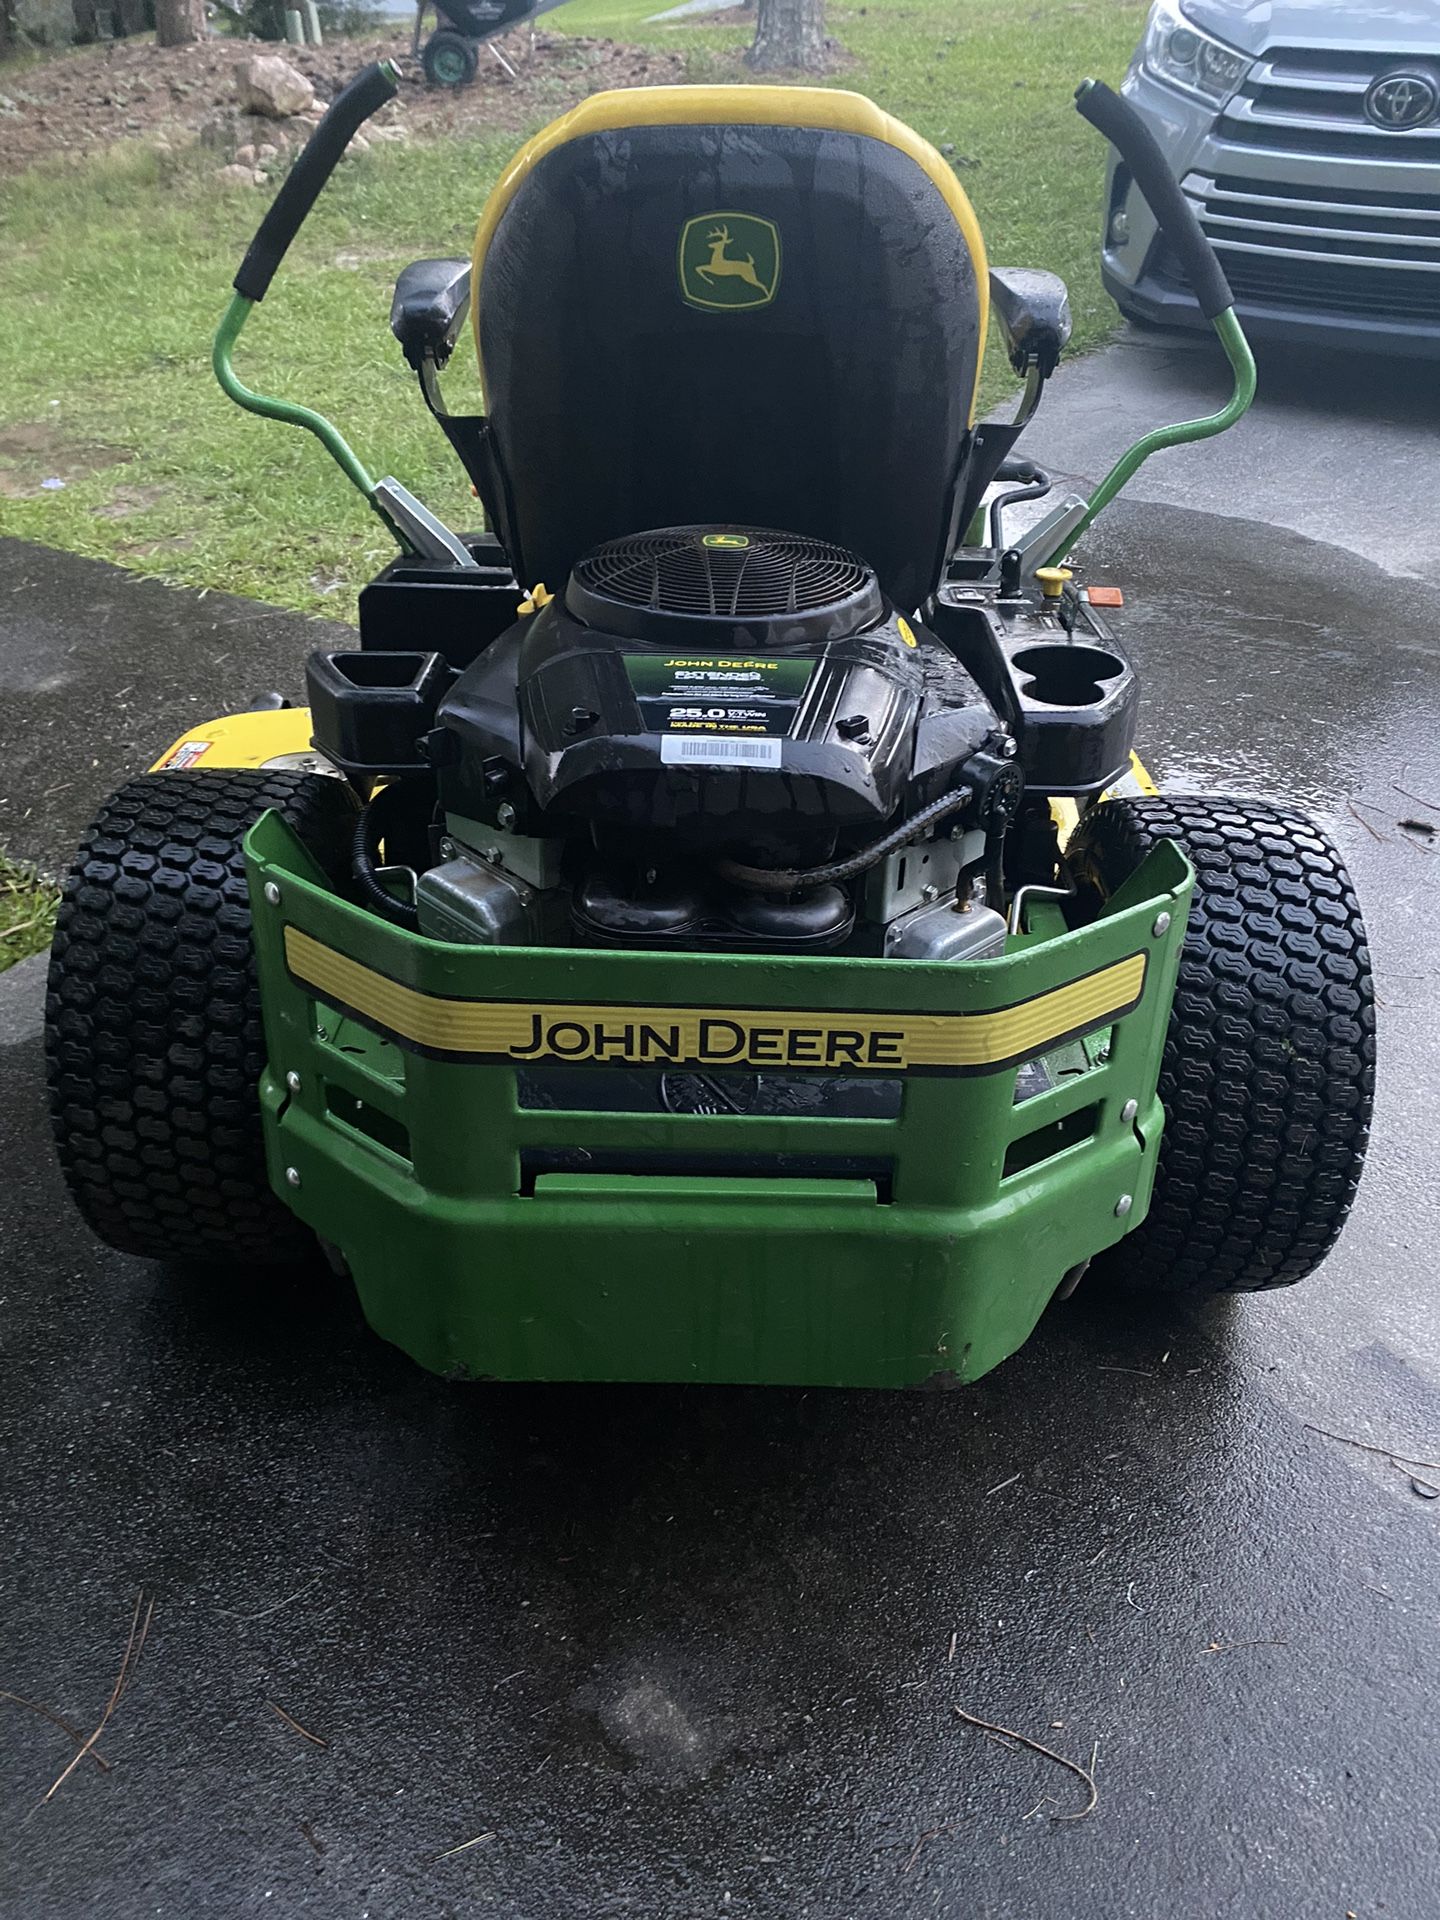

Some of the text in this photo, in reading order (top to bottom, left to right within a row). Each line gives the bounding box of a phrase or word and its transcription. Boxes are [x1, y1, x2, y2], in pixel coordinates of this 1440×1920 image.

[718, 660, 778, 669] DEERE
[669, 708, 725, 718] 25.0
[510, 1014, 905, 1064] JOHN DEERE
